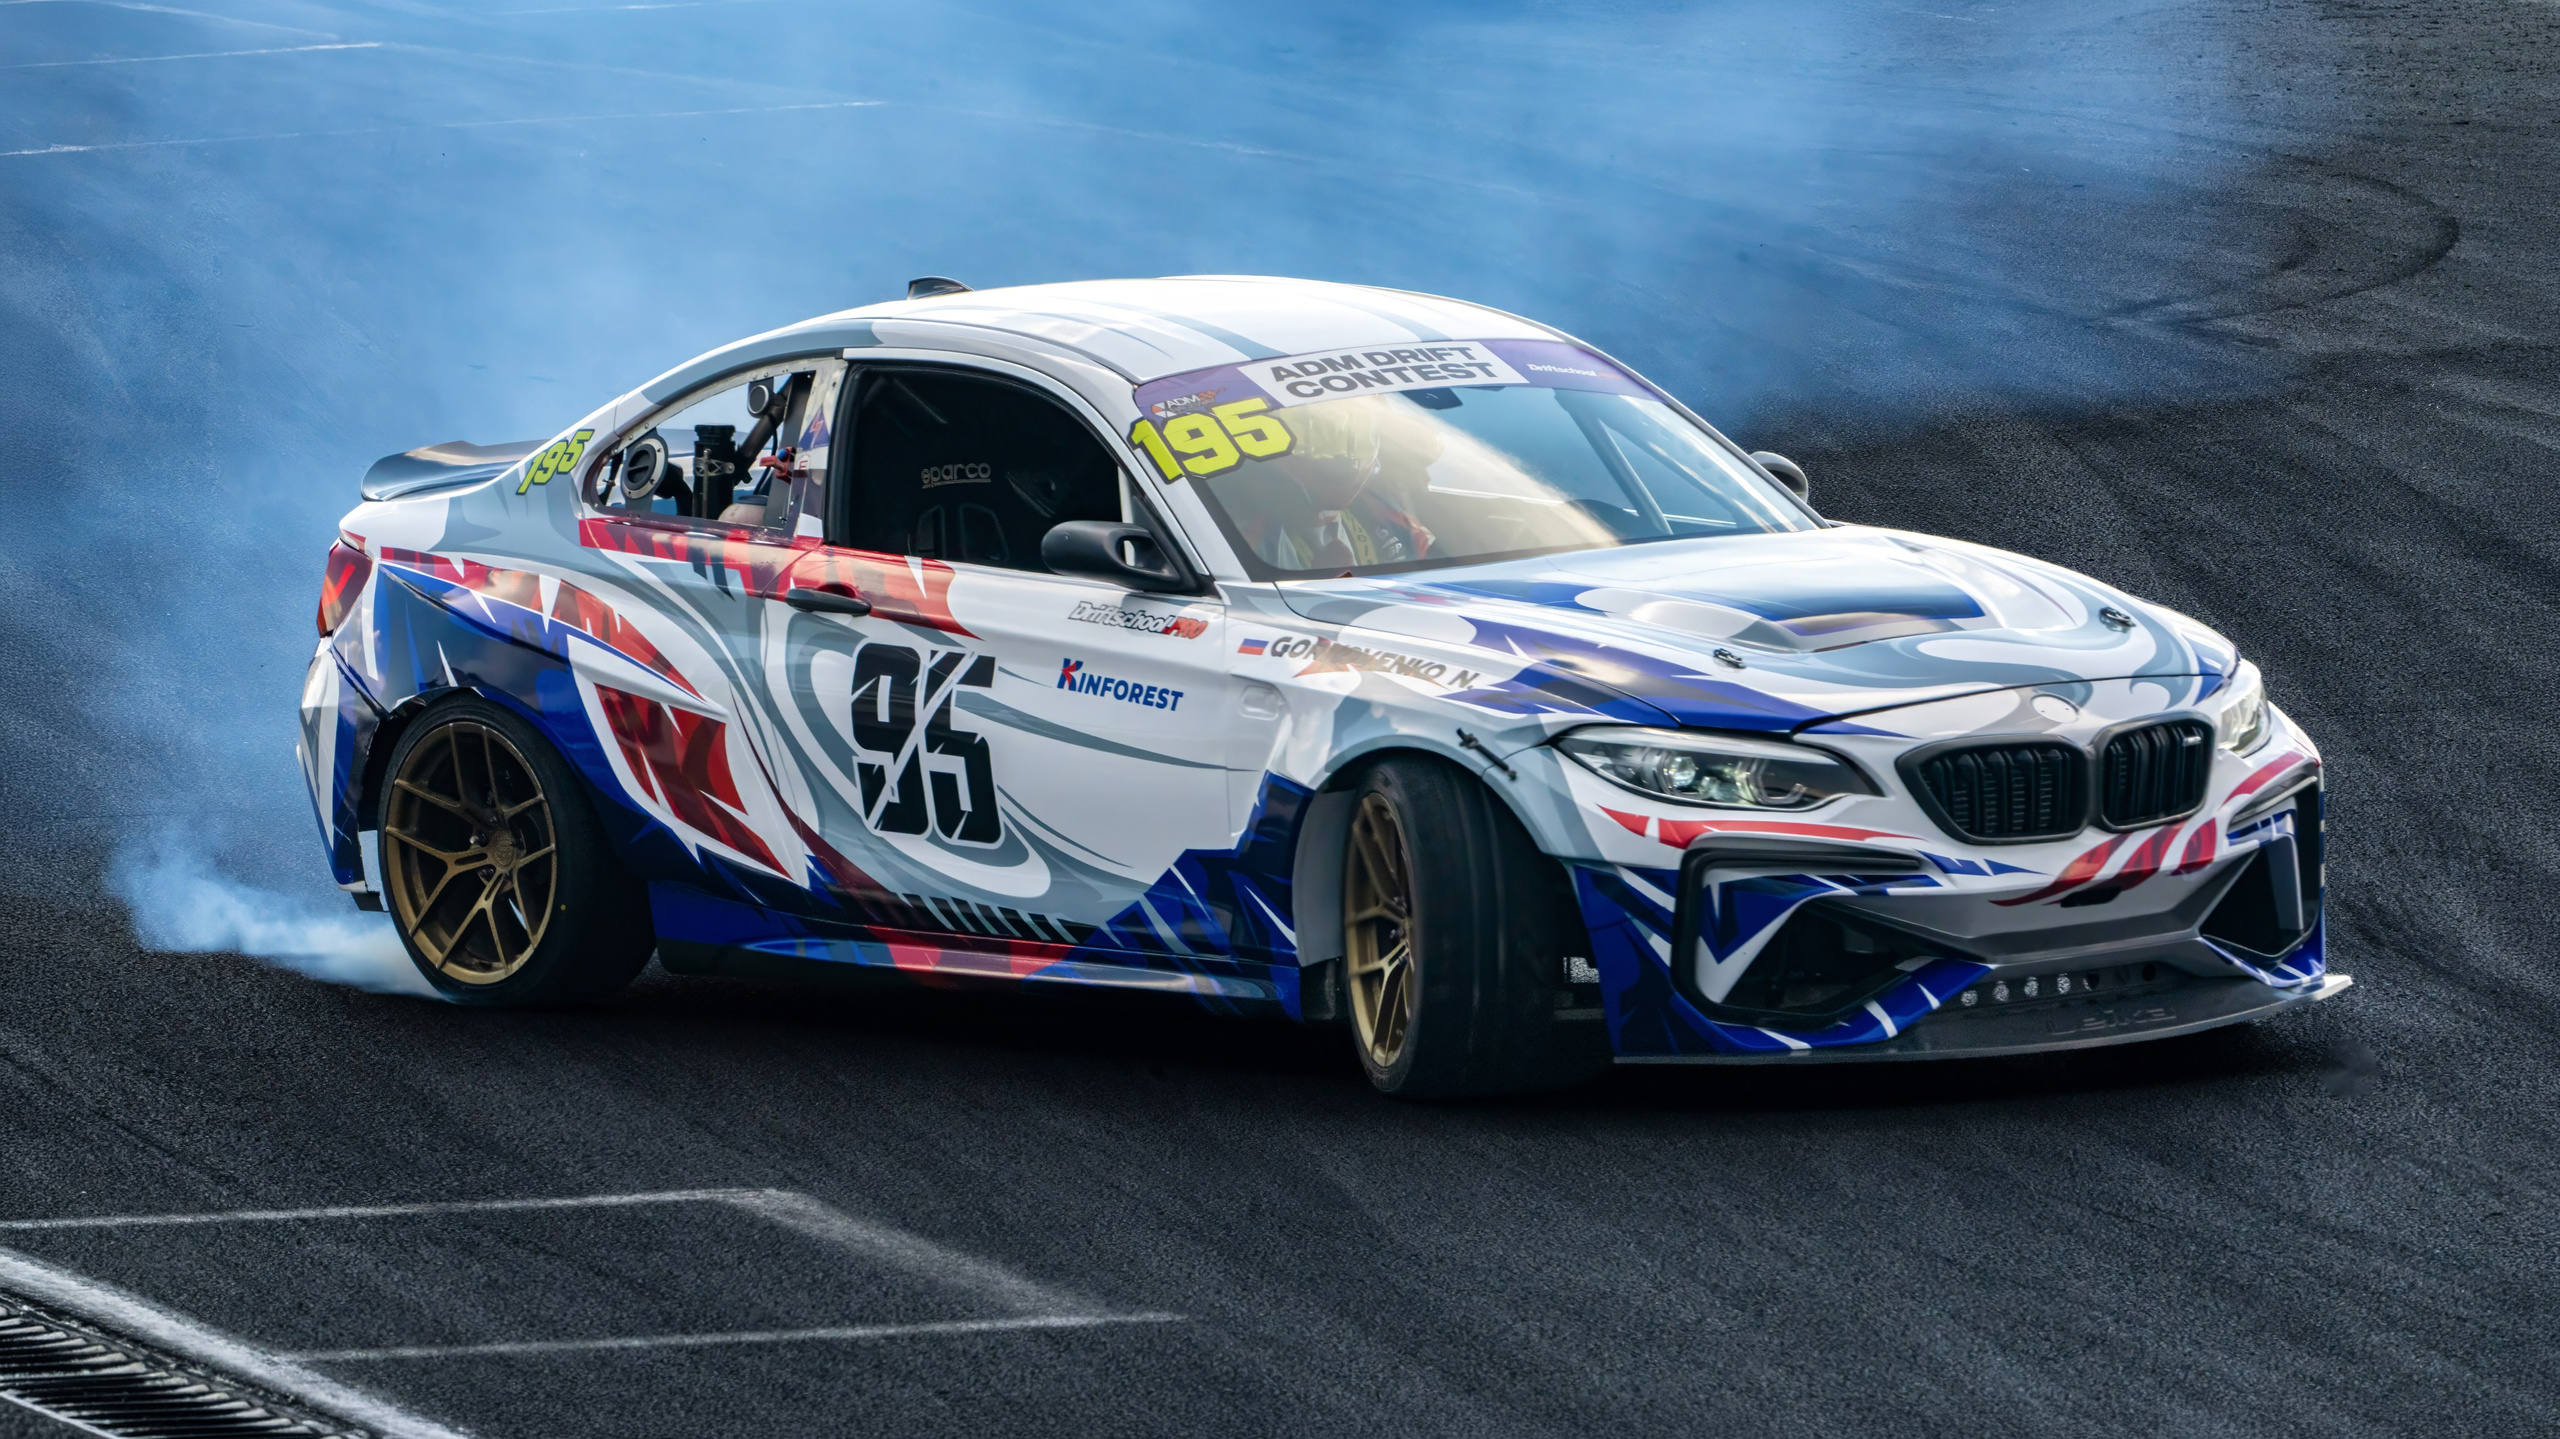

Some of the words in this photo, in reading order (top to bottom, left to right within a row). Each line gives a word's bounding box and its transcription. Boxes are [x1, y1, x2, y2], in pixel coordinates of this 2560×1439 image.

[1271, 355, 1366, 382] ADM
[1361, 347, 1478, 366] DRIFT
[1286, 362, 1498, 398] CONTEST
[1166, 394, 1200, 408] ADM
[1128, 396, 1296, 484] 195
[516, 429, 595, 495] 195
[921, 463, 991, 488] sparco
